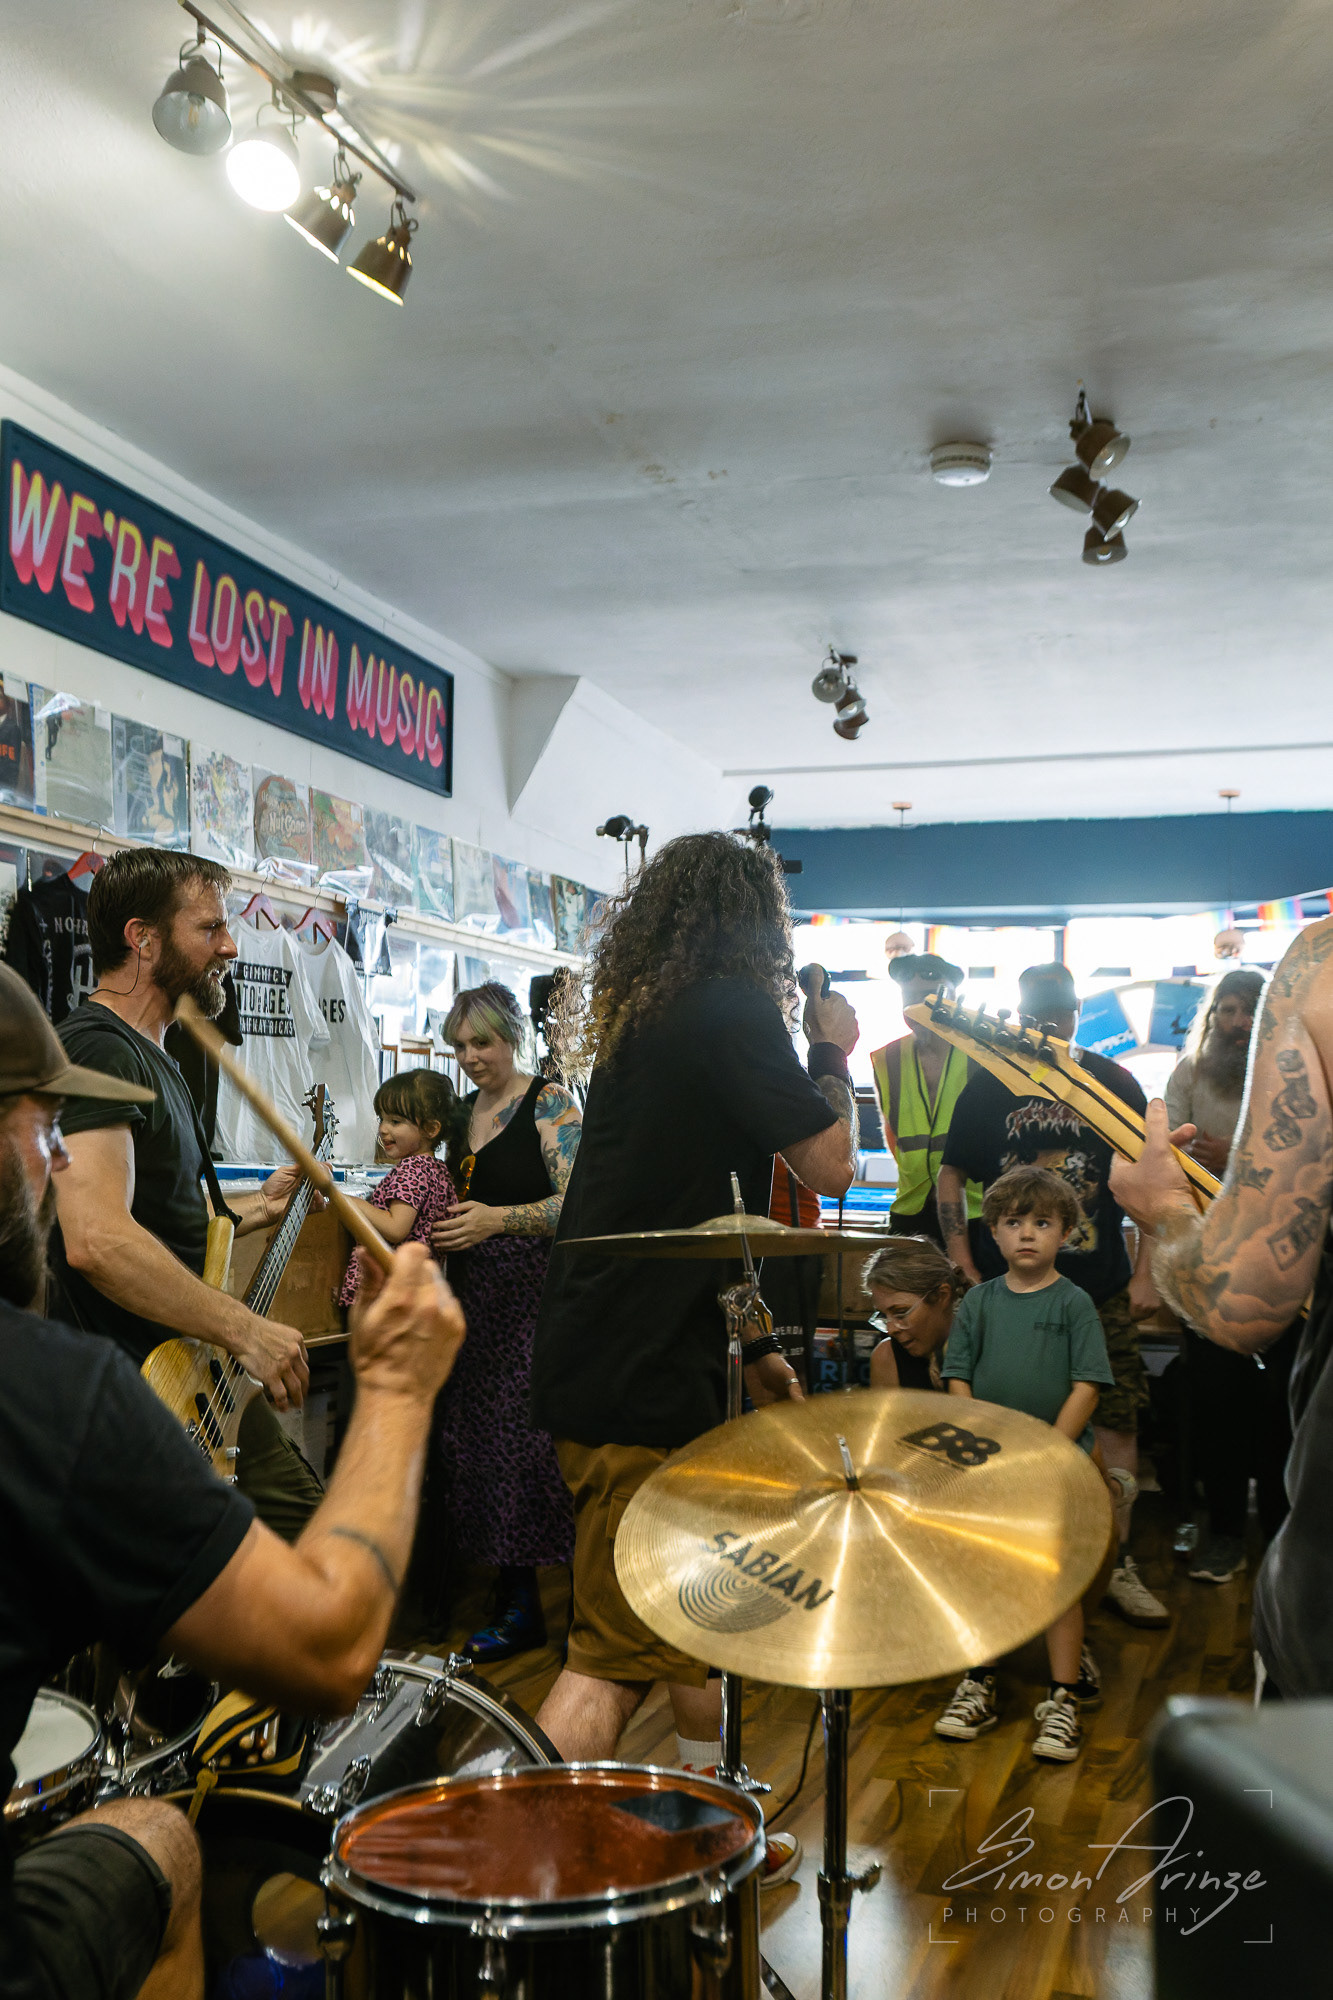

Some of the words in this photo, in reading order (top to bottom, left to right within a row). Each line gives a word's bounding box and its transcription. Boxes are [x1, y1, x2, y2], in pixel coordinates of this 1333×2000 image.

[9, 459, 182, 648] WE'RE
[188, 560, 294, 697] LOST
[298, 618, 339, 720] IN
[347, 643, 446, 768] MUSIC
[319, 998, 345, 1023] GES
[702, 1531, 834, 1610] SABIAN
